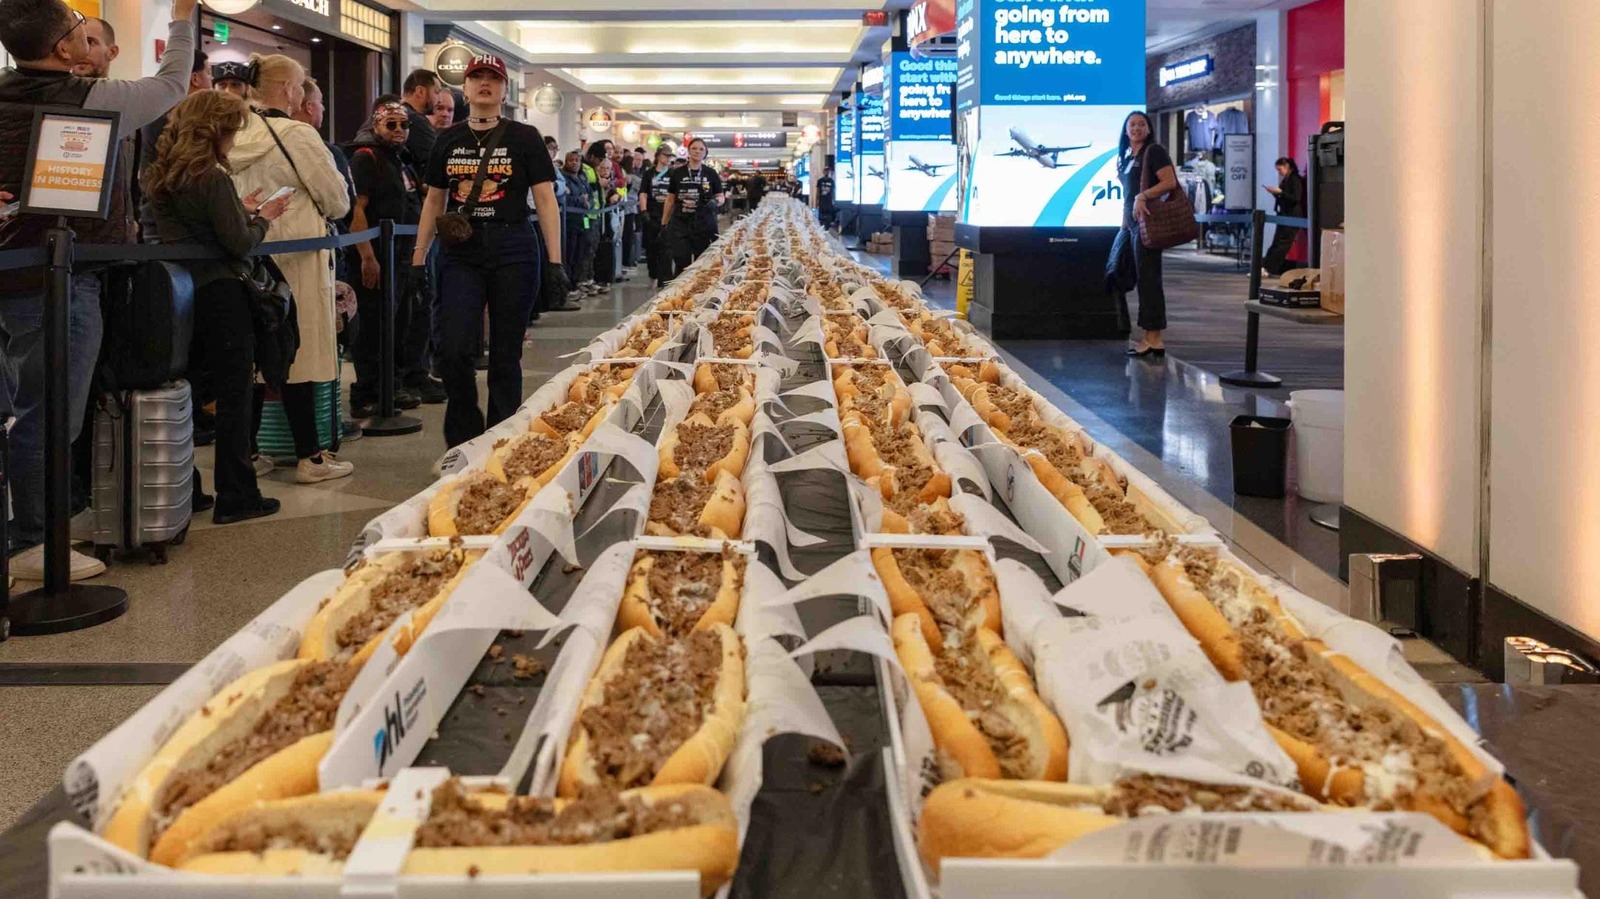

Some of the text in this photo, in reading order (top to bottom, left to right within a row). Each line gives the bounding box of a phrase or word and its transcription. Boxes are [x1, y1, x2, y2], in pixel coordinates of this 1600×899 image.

[995, 4, 1055, 27] going
[1059, 4, 1110, 23] from
[995, 25, 1042, 44] here
[1045, 26, 1069, 44] to
[474, 54, 501, 67] PHL
[994, 46, 1102, 69] anywhere.
[900, 60, 933, 71] Good
[900, 72, 929, 83] start
[930, 72, 957, 83] with
[899, 83, 935, 98] going
[900, 96, 943, 106] here to
[899, 108, 951, 121] anywher
[447, 158, 481, 166] LONGEST
[48, 165, 93, 176] HISTORY
[34, 175, 103, 188] IN PROGRESS
